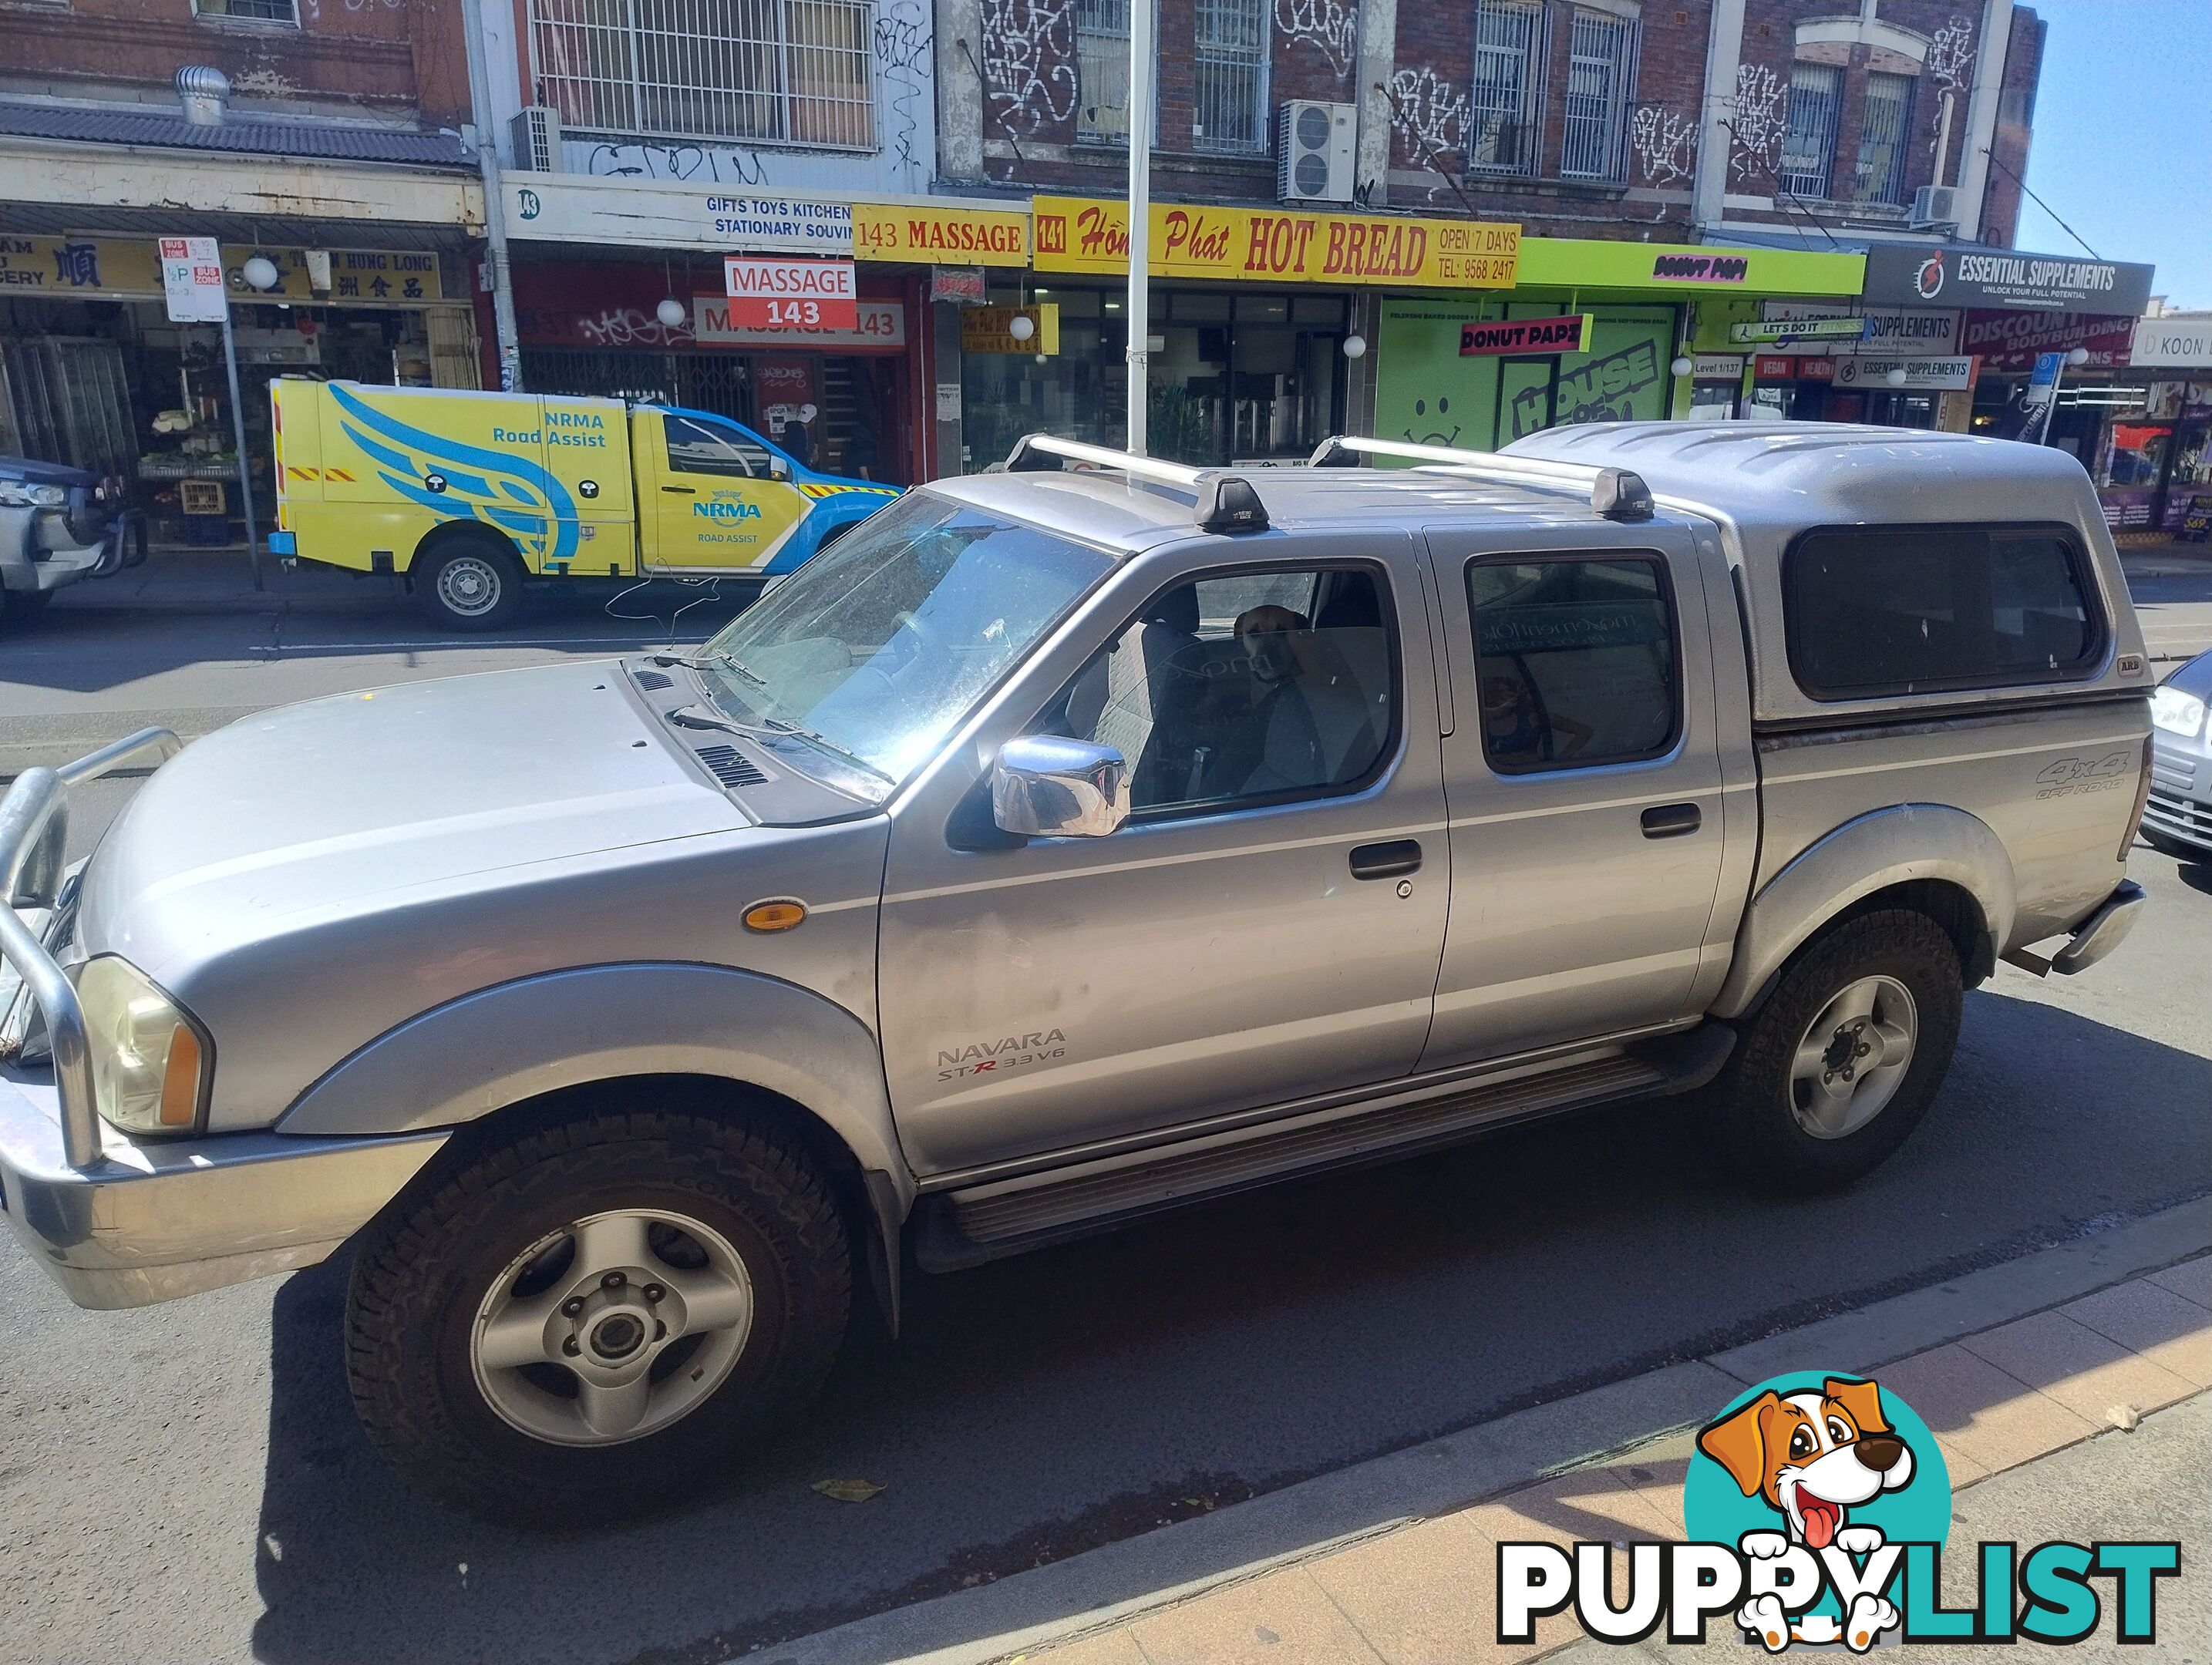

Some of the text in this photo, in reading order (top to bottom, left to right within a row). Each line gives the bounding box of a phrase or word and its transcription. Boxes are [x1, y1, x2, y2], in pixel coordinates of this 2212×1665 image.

[707, 197, 851, 220] GIFTS TOYS KITCHEN
[715, 218, 800, 236] STATIONARY
[858, 220, 1022, 253] 143 MASSAGE
[1039, 207, 1427, 278] 141 Hồn Phát HOT BREAD
[1439, 228, 1517, 252] OPEN 7 DAYS
[52, 243, 102, 288] 順
[348, 253, 386, 270] HUNG
[393, 255, 433, 271] LONG
[1438, 257, 1514, 281] TEL: 9568 2417
[1653, 256, 1748, 280] DONUT PAPI
[1958, 255, 2116, 291] ESSENTIAL SUPPLEMENTS
[732, 267, 849, 294] MASSAGE
[1982, 285, 2086, 299] UNLOCK YOUR FULL POTENTIAL
[767, 301, 820, 325] 143
[1462, 325, 1581, 348] DONUT PAPI
[1763, 321, 1862, 334] LET'S DO IT FITNESS
[1871, 315, 1951, 338] SUPPLEMENTS
[1968, 311, 2079, 345] DISCOUNT
[2006, 317, 2131, 351] BODYBUILDING
[2161, 337, 2204, 355] KOON
[1696, 364, 1739, 373] Level 1/137
[1763, 361, 1786, 375] VEGAN
[1805, 362, 1830, 375] HEALTH
[1907, 362, 1967, 375] SUPPLEMENTS
[1517, 345, 1655, 434] HOUSE
[1572, 394, 1606, 423] OF
[545, 412, 604, 429] NRMA
[493, 427, 606, 447] Road Assist
[693, 502, 762, 518] NRMA
[698, 533, 758, 543] ROAD ASSIST
[2121, 660, 2140, 671] ARB
[2036, 751, 2130, 784] 4x4
[2036, 779, 2124, 800] OFF ROAD
[938, 1028, 1066, 1067] NAVARA
[938, 1048, 1066, 1083] ST-R 3.3 V6
